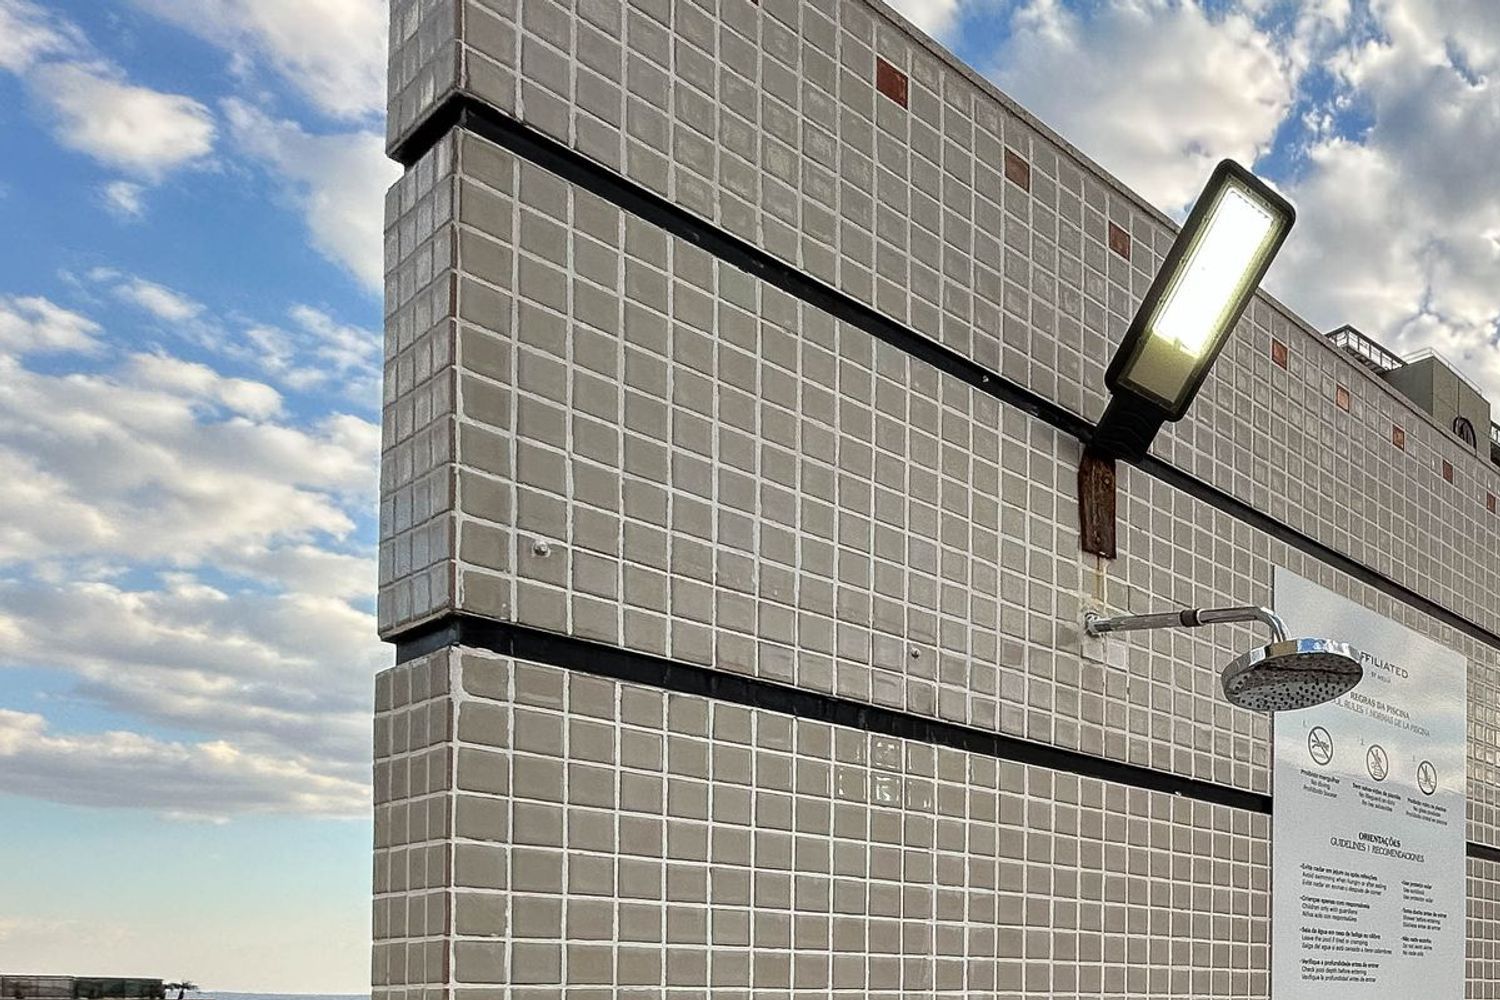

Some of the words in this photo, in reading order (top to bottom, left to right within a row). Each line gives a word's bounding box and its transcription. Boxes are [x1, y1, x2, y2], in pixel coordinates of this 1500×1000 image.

[1361, 651, 1409, 680] FFILIATED
[1350, 691, 1376, 708] REGRAS
[1376, 702, 1386, 711] DA
[1386, 704, 1410, 720] PISCINA
[1330, 836, 1366, 852] GUIDELINES
[1358, 831, 1401, 848] ORIENTAÇÕES
